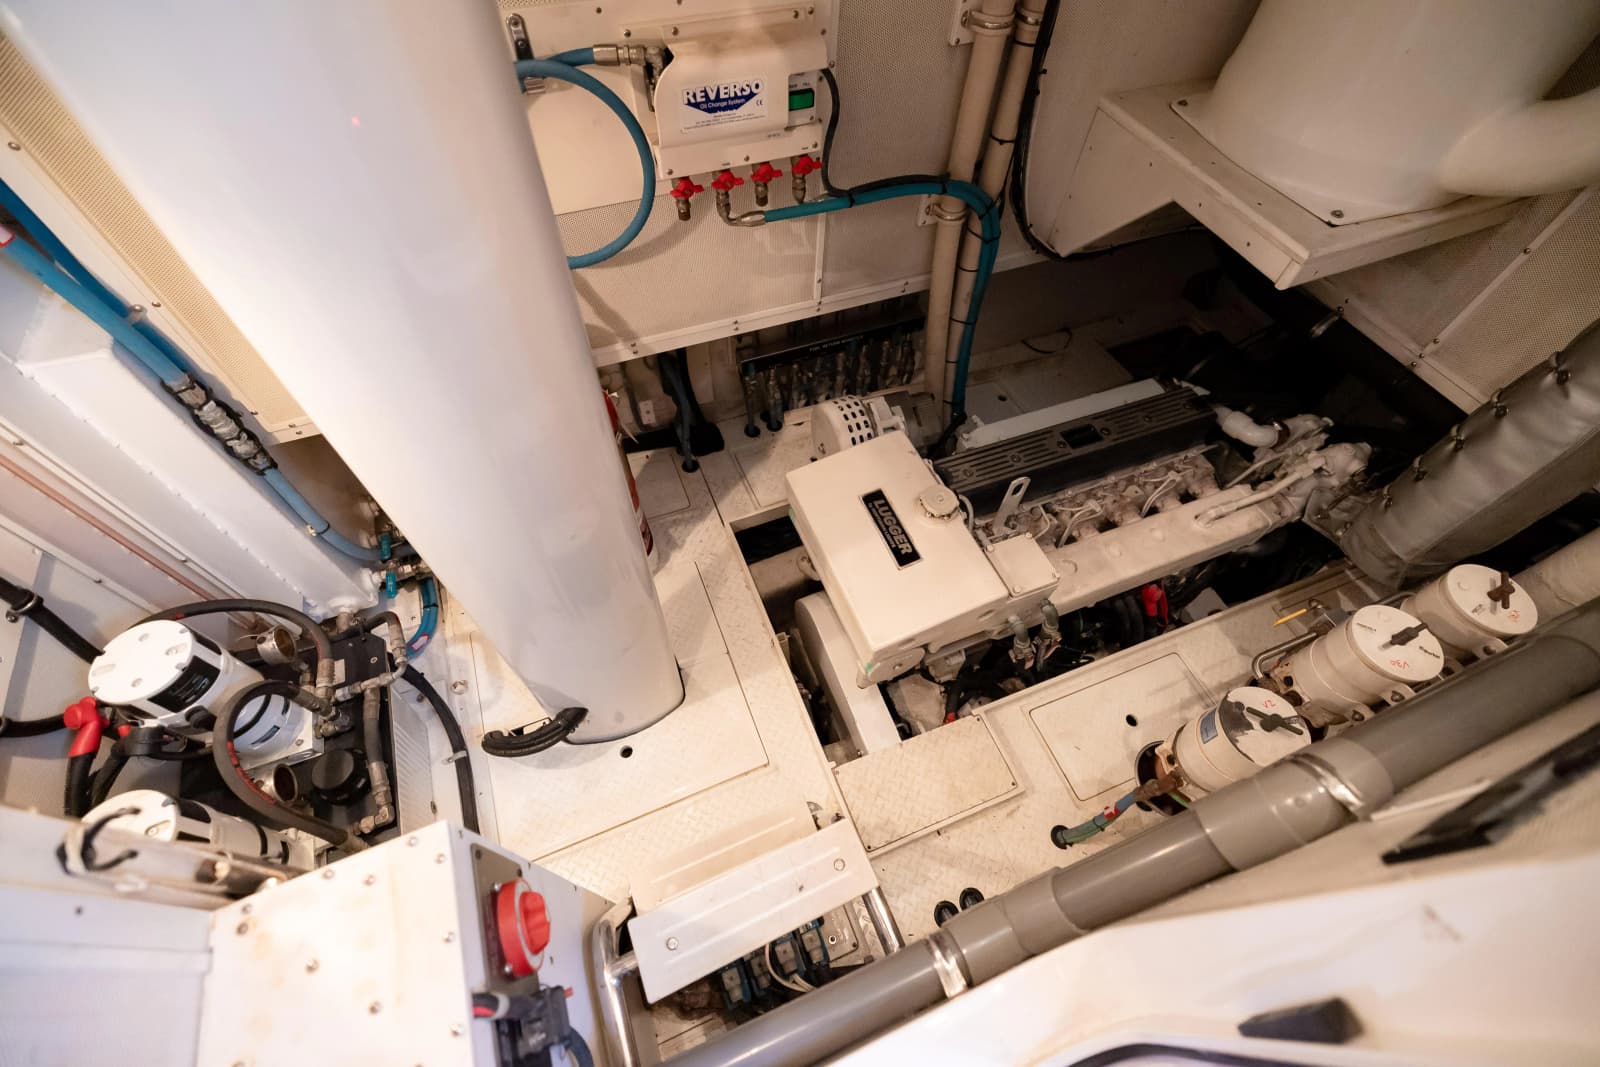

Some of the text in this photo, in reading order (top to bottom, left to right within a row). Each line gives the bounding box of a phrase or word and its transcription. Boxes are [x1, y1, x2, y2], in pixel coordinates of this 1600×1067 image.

[682, 79, 763, 105] REVERSO
[708, 100, 728, 108] Change
[873, 499, 913, 555] LUGGER
